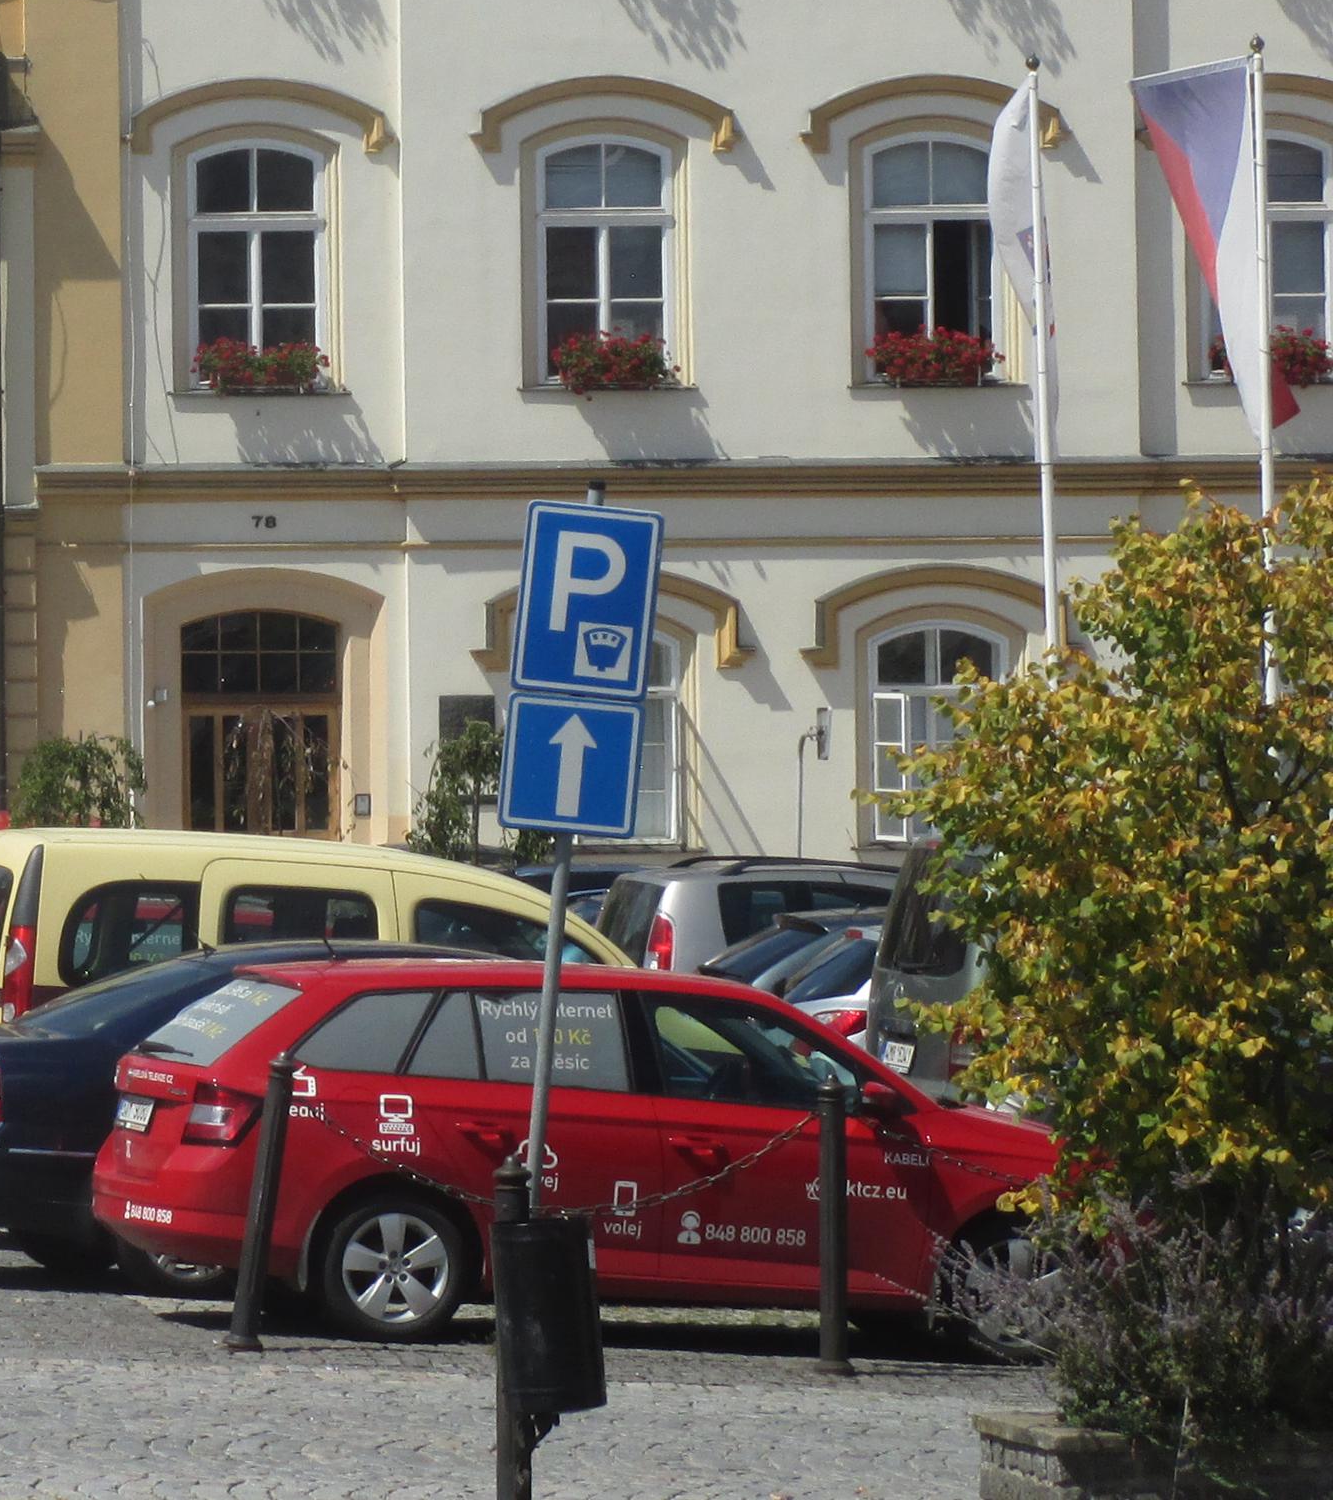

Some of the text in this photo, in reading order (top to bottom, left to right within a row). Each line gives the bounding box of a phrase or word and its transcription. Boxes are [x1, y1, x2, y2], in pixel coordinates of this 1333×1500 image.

[251, 515, 277, 529] 78
[549, 531, 626, 632] P
[480, 1000, 538, 1021] Rychlý
[505, 1028, 592, 1045] od 10 Kč
[510, 1056, 531, 1069] za
[371, 1137, 421, 1157] surfuj
[603, 1220, 643, 1241] volej
[705, 1224, 806, 1246] 848 800 858
